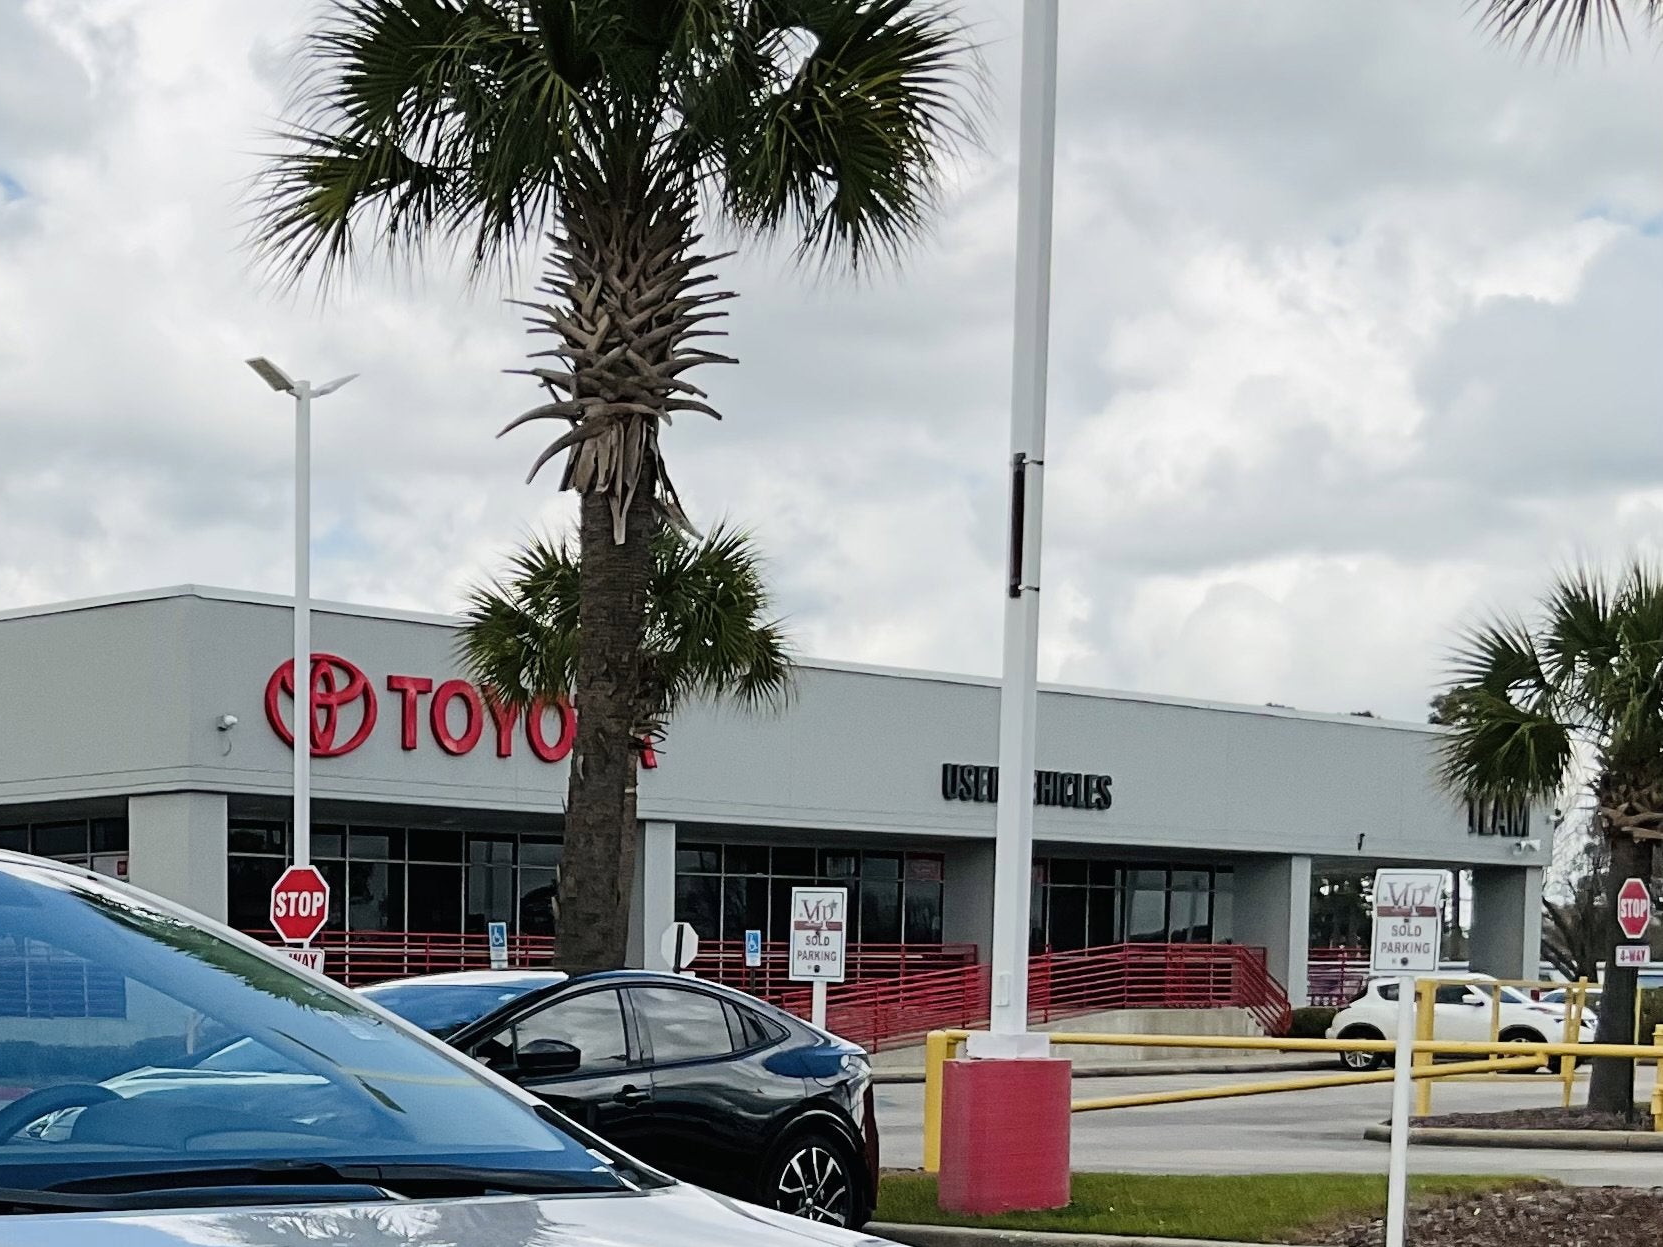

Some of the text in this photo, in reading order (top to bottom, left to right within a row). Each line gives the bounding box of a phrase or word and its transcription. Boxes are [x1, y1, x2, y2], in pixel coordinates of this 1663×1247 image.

[387, 674, 657, 769] TOYO
[1033, 769, 1113, 811] HICLES
[275, 891, 324, 917] STOP
[1620, 898, 1647, 918] STOP
[1391, 925, 1422, 937] SOLD
[805, 935, 830, 946] SOLD
[1380, 942, 1430, 954] PARKING
[796, 951, 837, 962] PARKING
[1620, 950, 1645, 962] 4-WAY
